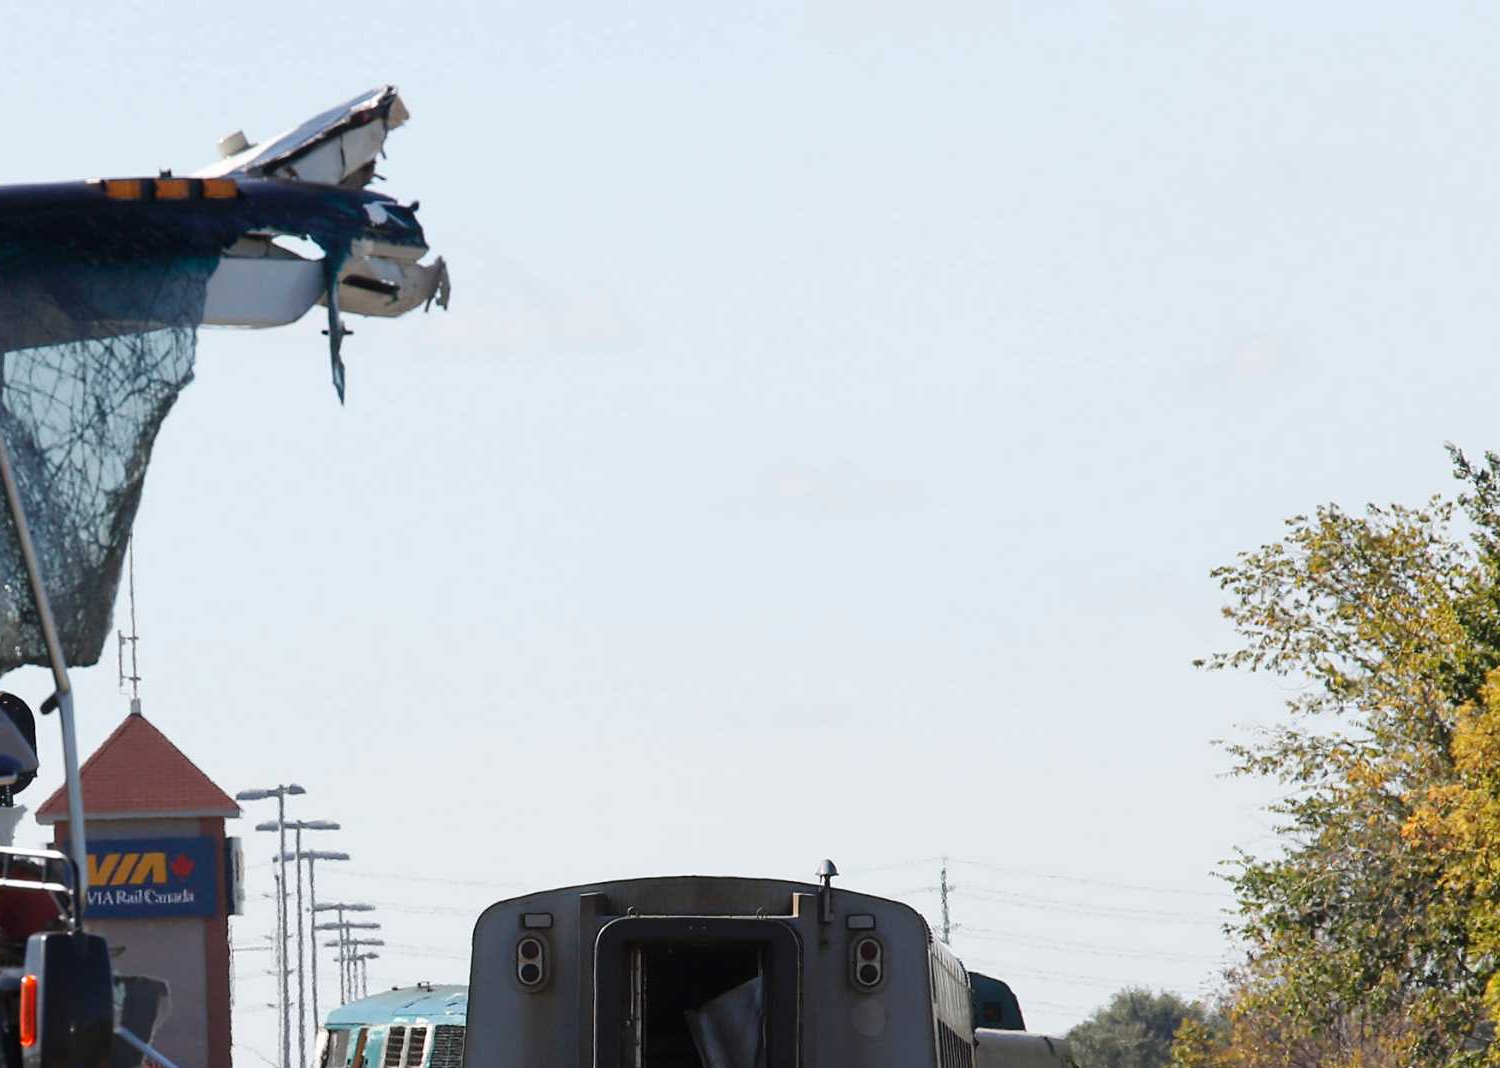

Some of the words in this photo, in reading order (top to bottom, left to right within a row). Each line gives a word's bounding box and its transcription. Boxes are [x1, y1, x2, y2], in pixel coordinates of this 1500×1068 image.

[86, 852, 168, 886] VIA
[86, 889, 114, 905] VIA
[115, 888, 143, 904] Rail
[144, 888, 195, 904] Canada
